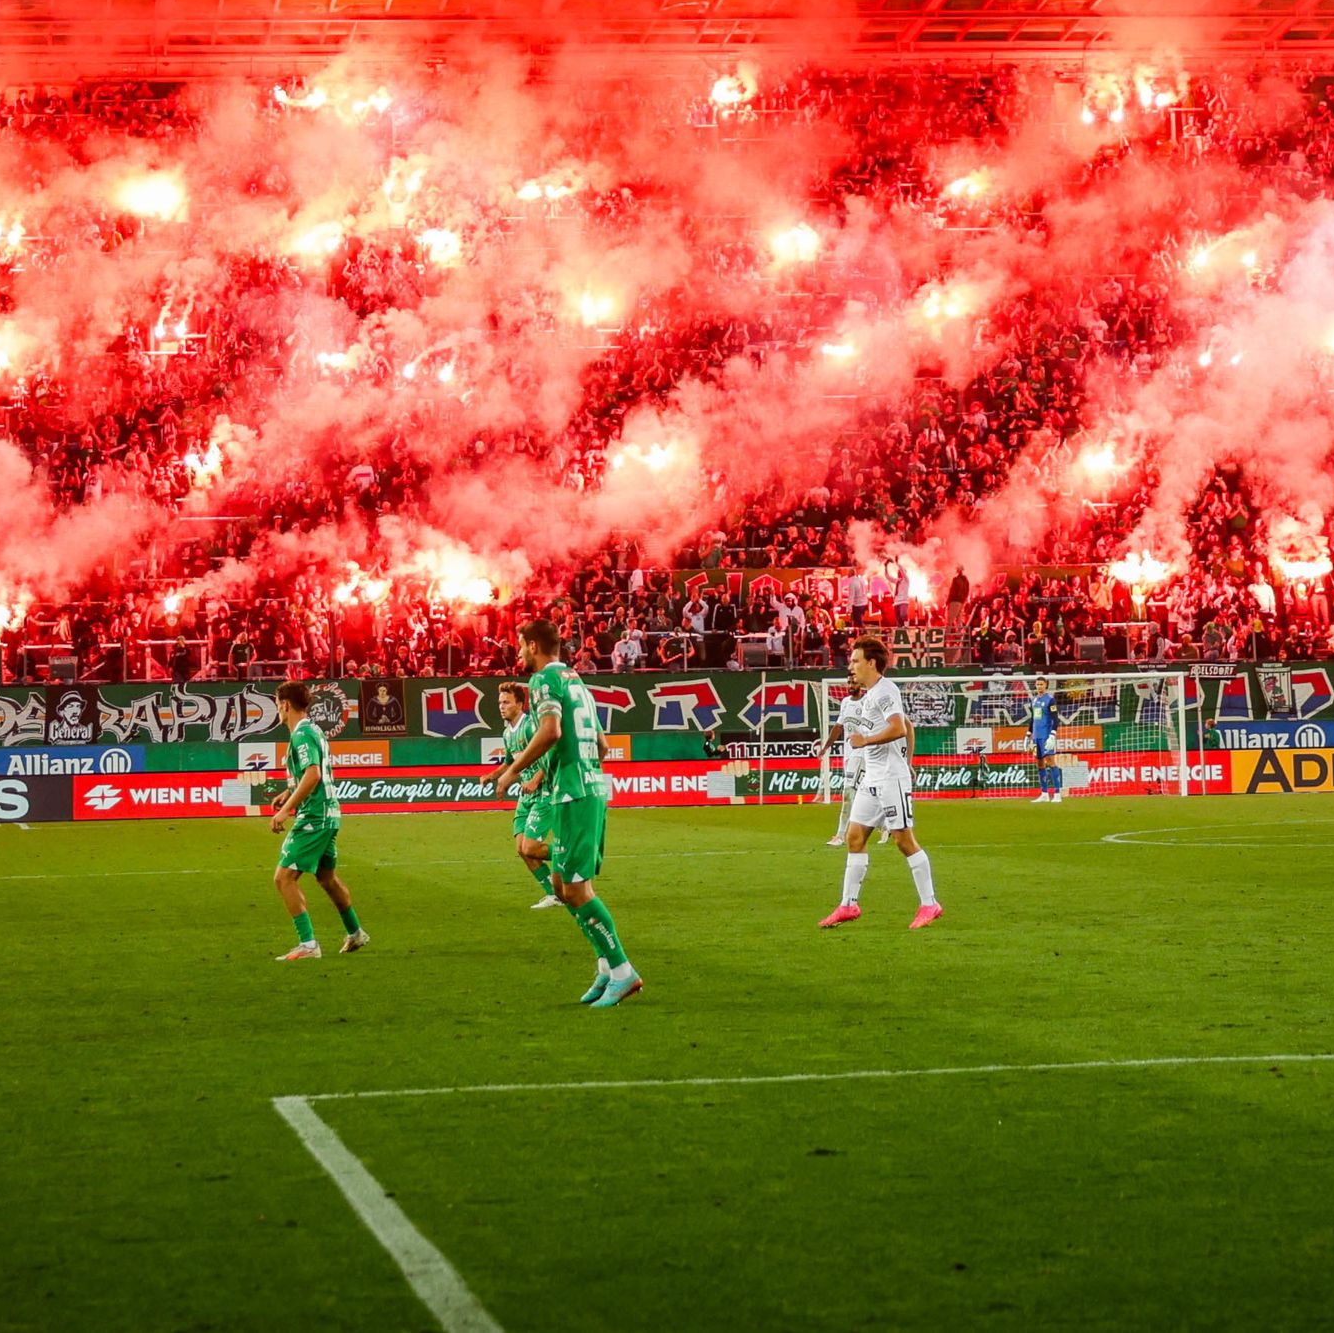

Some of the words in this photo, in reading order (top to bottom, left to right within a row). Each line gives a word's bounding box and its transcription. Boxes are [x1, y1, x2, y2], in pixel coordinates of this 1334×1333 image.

[97, 682, 280, 744] RAPID
[49, 719, 94, 741] General
[7, 754, 94, 776] Allianz
[1085, 767, 1135, 783] WIEN
[612, 777, 666, 794] WIEN
[769, 771, 798, 792] Mit
[917, 769, 932, 787] in
[934, 767, 971, 791] jede
[129, 786, 183, 804] WIEN
[369, 774, 436, 808] Energie
[438, 778, 453, 796] in
